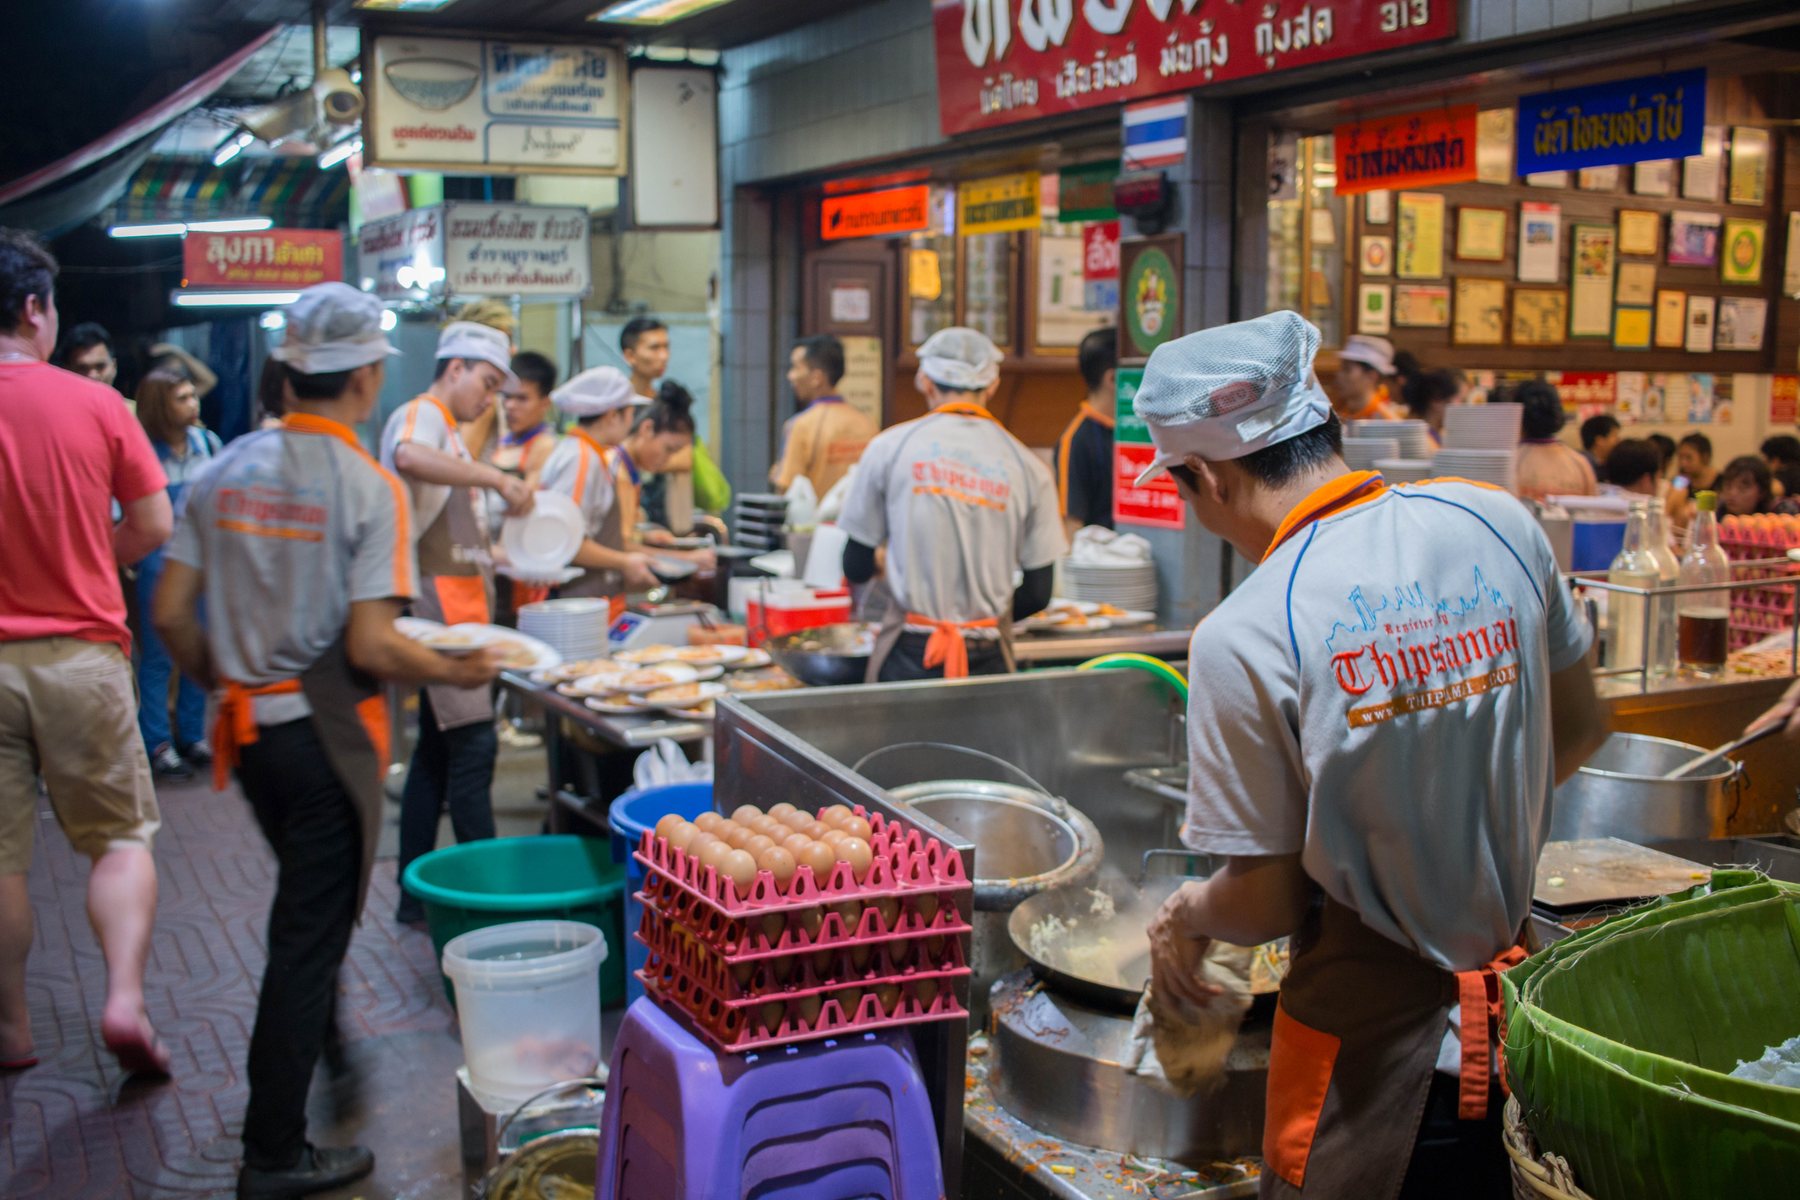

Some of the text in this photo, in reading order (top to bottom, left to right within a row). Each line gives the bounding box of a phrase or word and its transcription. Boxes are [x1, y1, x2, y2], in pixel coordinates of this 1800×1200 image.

[1255, 4, 1333, 69] กุ้งสด
[1380, 0, 1430, 33] 313
[206, 236, 275, 275] ลุงภา
[1330, 607, 1520, 696] Thipsamai
